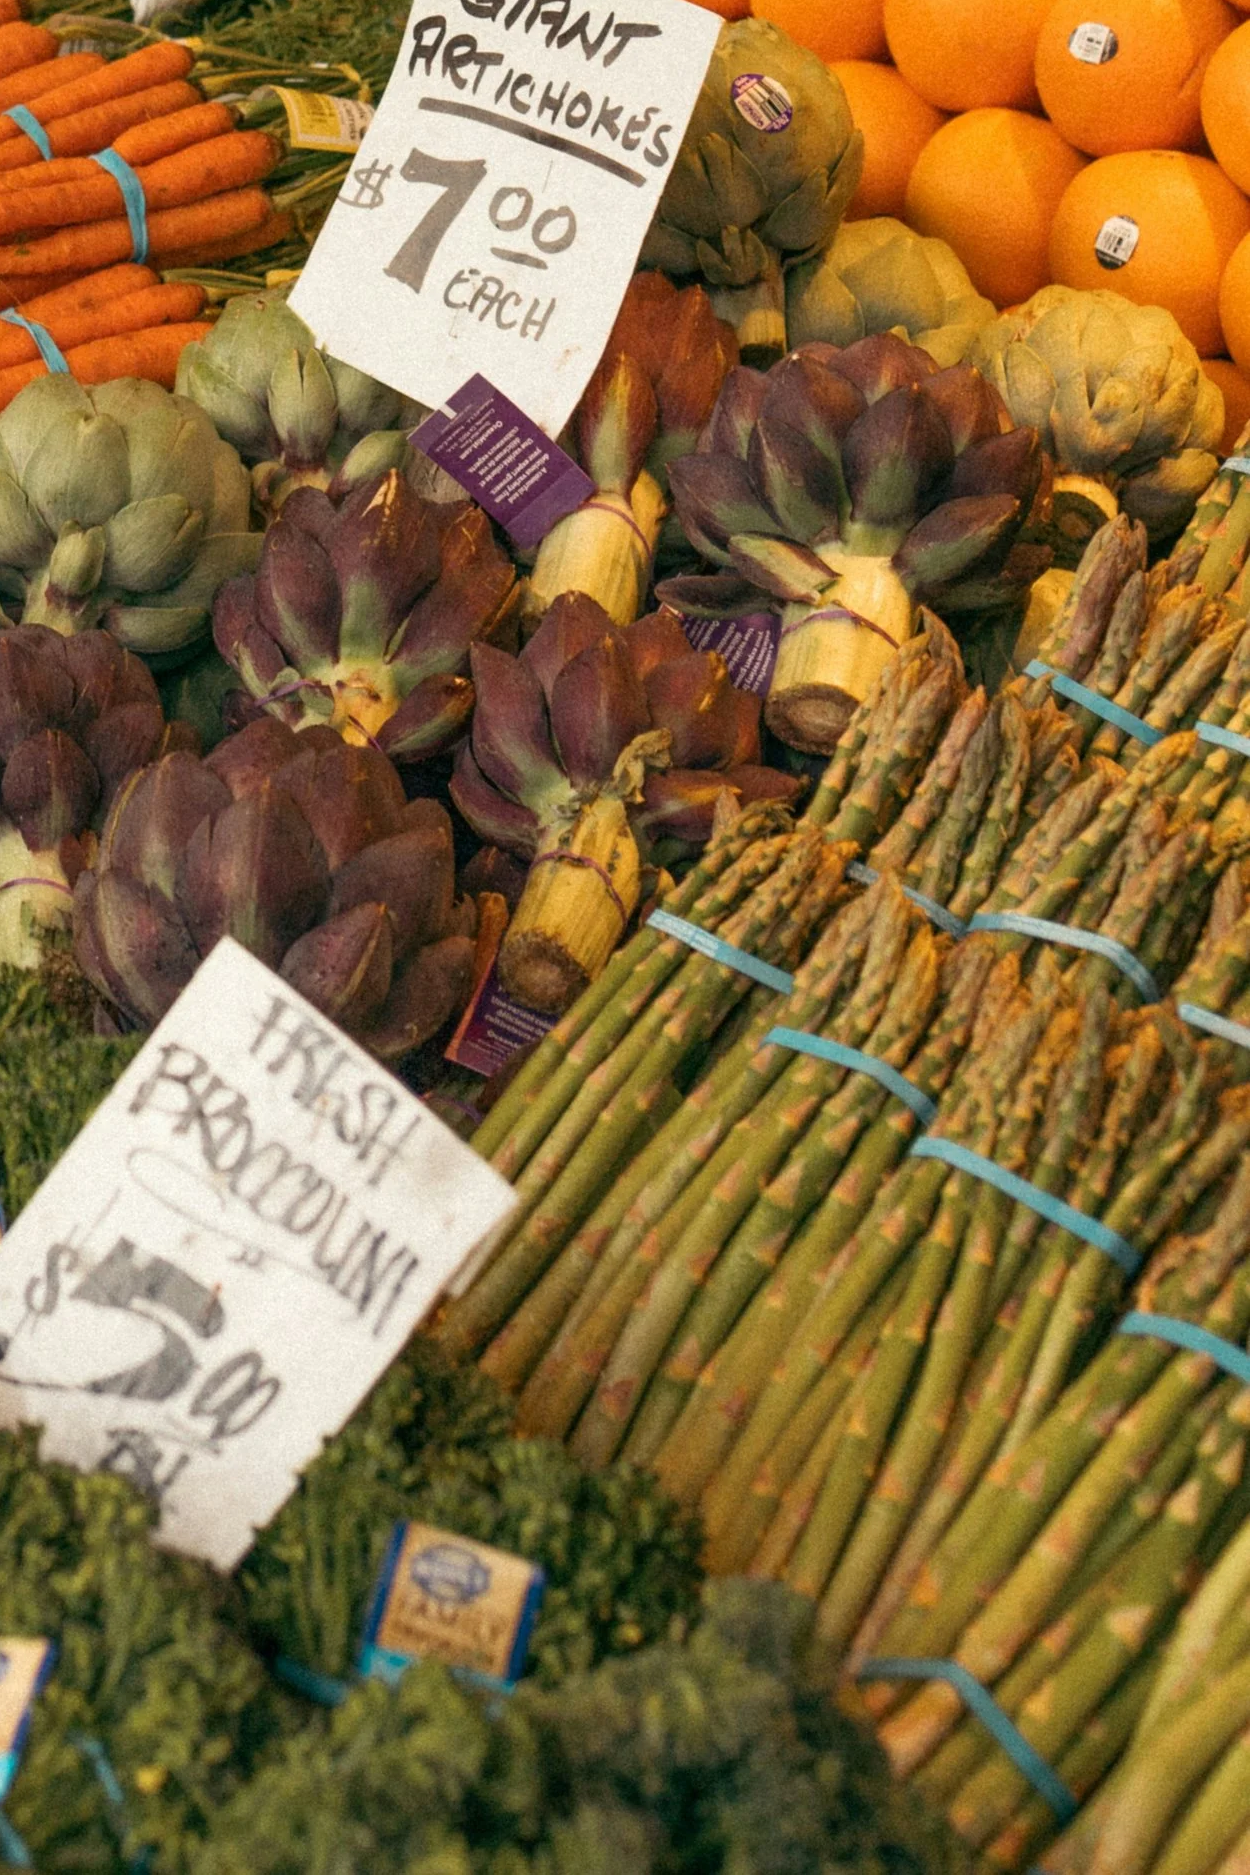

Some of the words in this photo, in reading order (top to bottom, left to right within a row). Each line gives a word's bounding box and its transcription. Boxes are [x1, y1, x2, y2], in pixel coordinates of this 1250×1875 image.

[408, 15, 670, 167] ARTICHOKES
[443, 268, 555, 342] EACH
[252, 994, 420, 1188] FRESH
